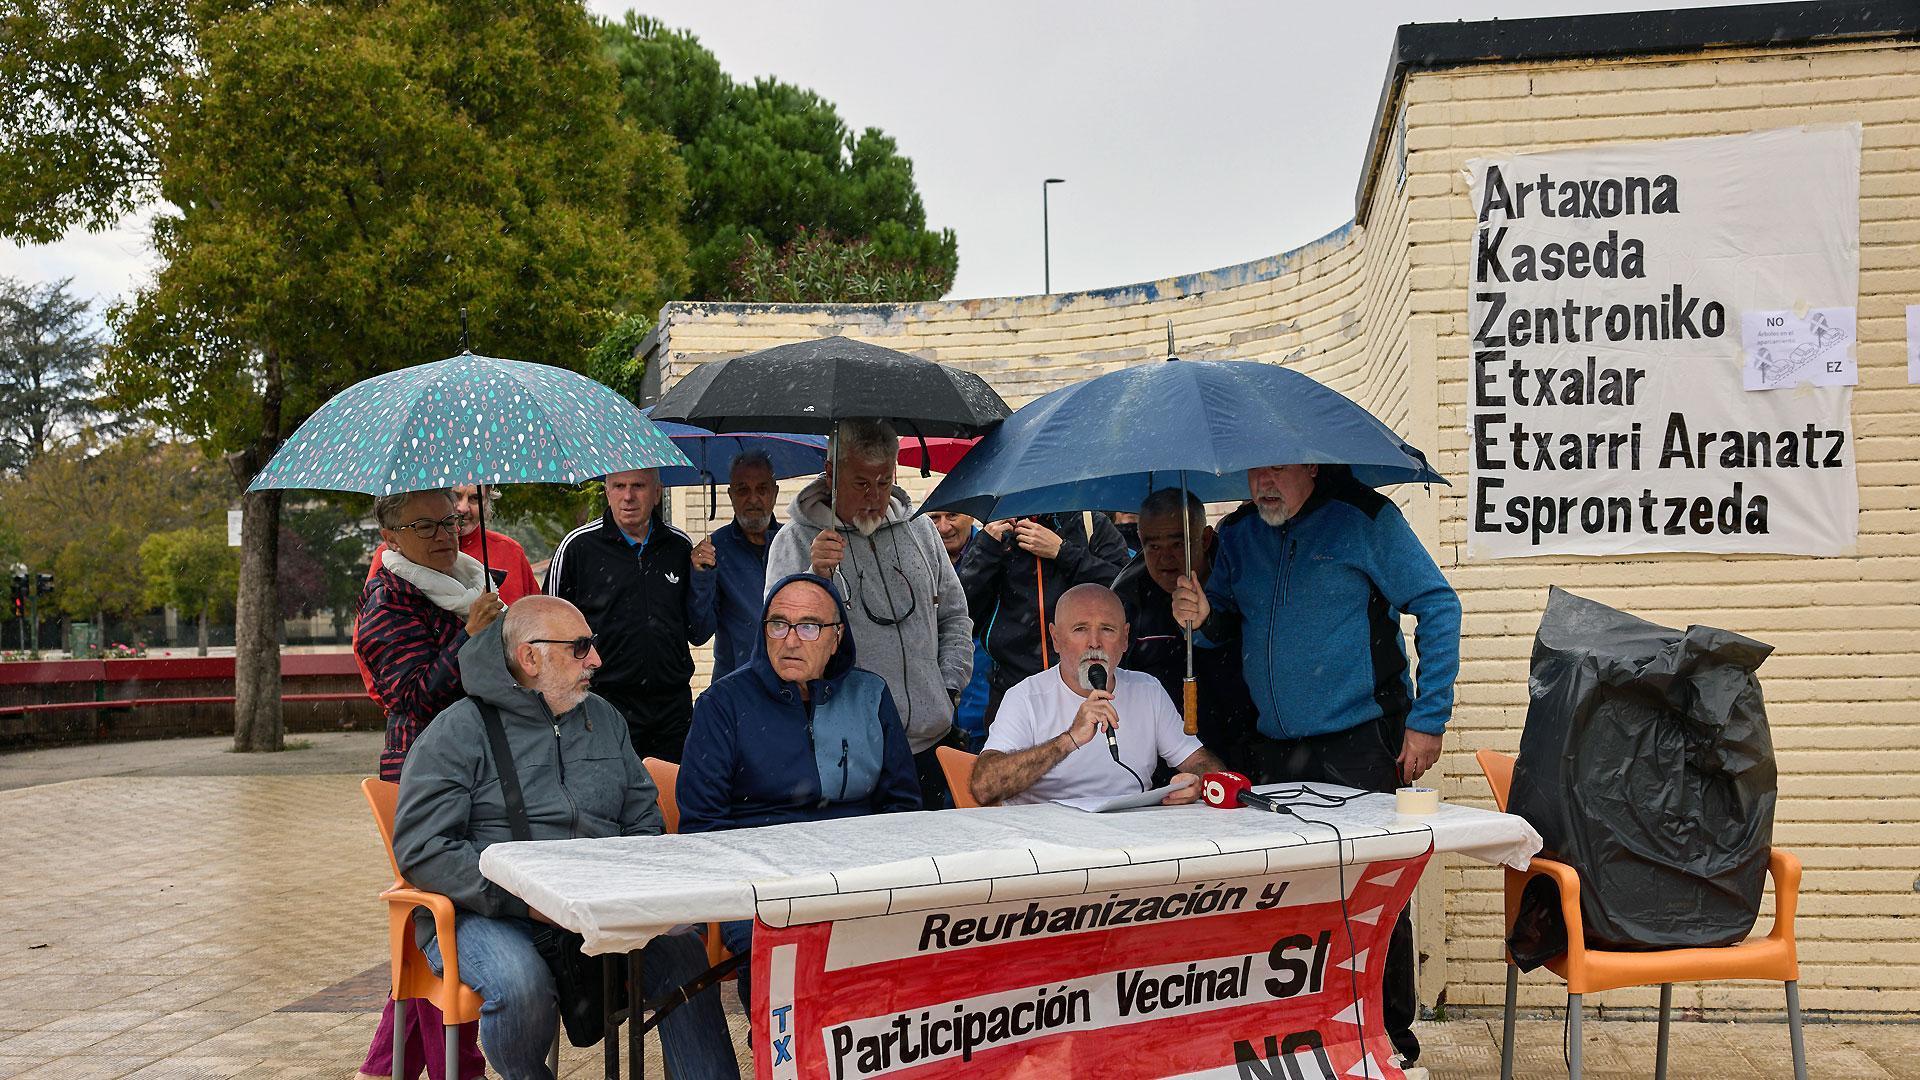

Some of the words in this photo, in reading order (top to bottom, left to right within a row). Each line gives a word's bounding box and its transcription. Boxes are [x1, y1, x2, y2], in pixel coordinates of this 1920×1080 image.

[1479, 165, 1680, 222] Artaxona
[1476, 227, 1646, 283] Kaseda
[1474, 284, 1725, 348] Zentroniko
[1767, 317, 1784, 327] NO
[1474, 350, 1646, 407] Etxalar
[1826, 361, 1842, 373] EZ
[1474, 413, 1641, 471] Etxarri
[1659, 412, 1845, 470] Aranatz
[1474, 477, 1770, 545] Esprontzeda
[918, 882, 1248, 951] Reurbanización
[1256, 881, 1289, 910] y
[832, 986, 1091, 1080] Participación
[1117, 956, 1252, 1016] Vecinal
[1265, 930, 1331, 998] SI
